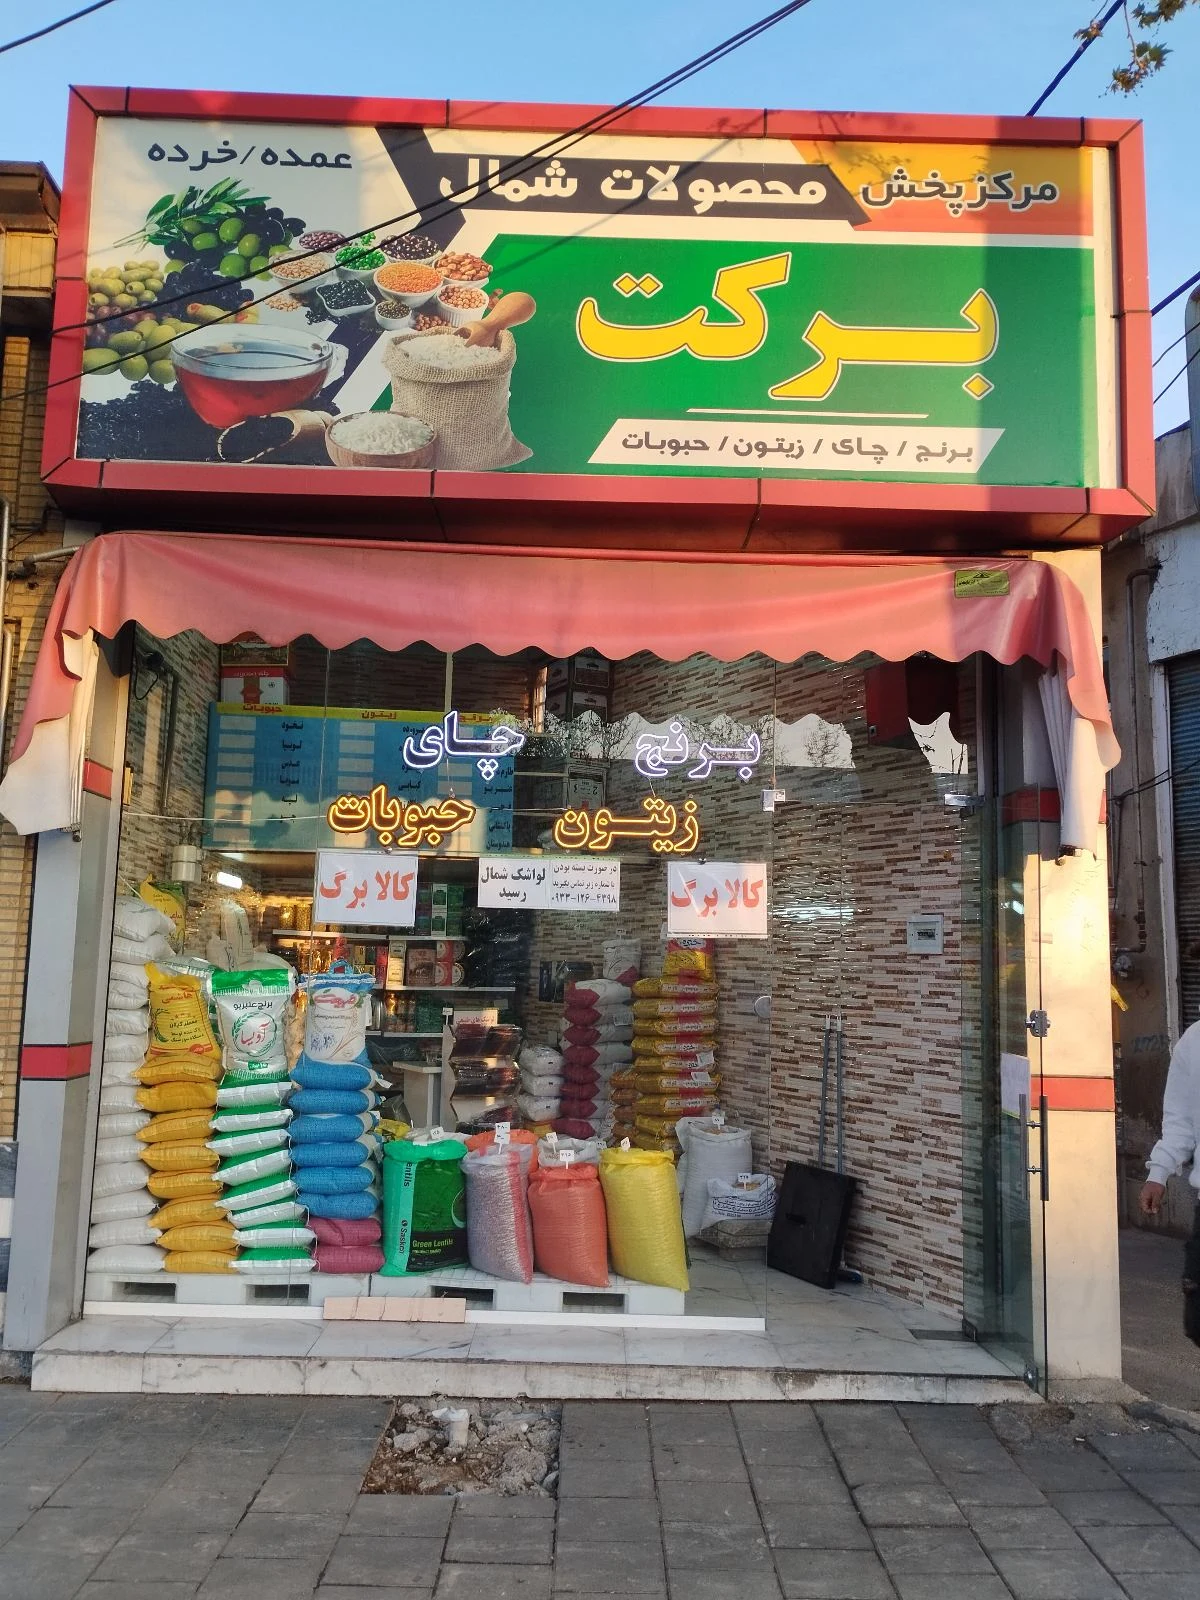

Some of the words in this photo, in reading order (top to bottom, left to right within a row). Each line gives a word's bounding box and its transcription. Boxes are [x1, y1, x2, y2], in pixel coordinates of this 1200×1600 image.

[439, 159, 578, 203] شمال
[600, 165, 827, 214] محصولات
[861, 167, 964, 216] پخش
[967, 171, 1058, 210] مرکز
[576, 251, 999, 401] برکت
[621, 431, 710, 456] حبوبات
[733, 437, 805, 460] زیتون
[832, 437, 889, 464] چای
[915, 441, 973, 463] برنج
[402, 710, 526, 781] چای
[634, 721, 763, 779] برنج
[326, 784, 476, 847] حبوبات
[554, 797, 700, 853] زیتون
[481, 866, 508, 883] شمال
[511, 867, 546, 885] لواشک
[553, 863, 570, 874] بودن
[571, 864, 586, 873] بسته
[588, 865, 608, 875] صورت
[320, 869, 368, 909] برگ
[375, 870, 415, 901] کالا
[499, 887, 527, 902] رسید
[594, 880, 609, 889] شماره
[671, 879, 718, 917] برگ
[725, 878, 763, 908] کالا
[257, 1000, 273, 1010] برنج
[412, 1239, 432, 1248] Green
